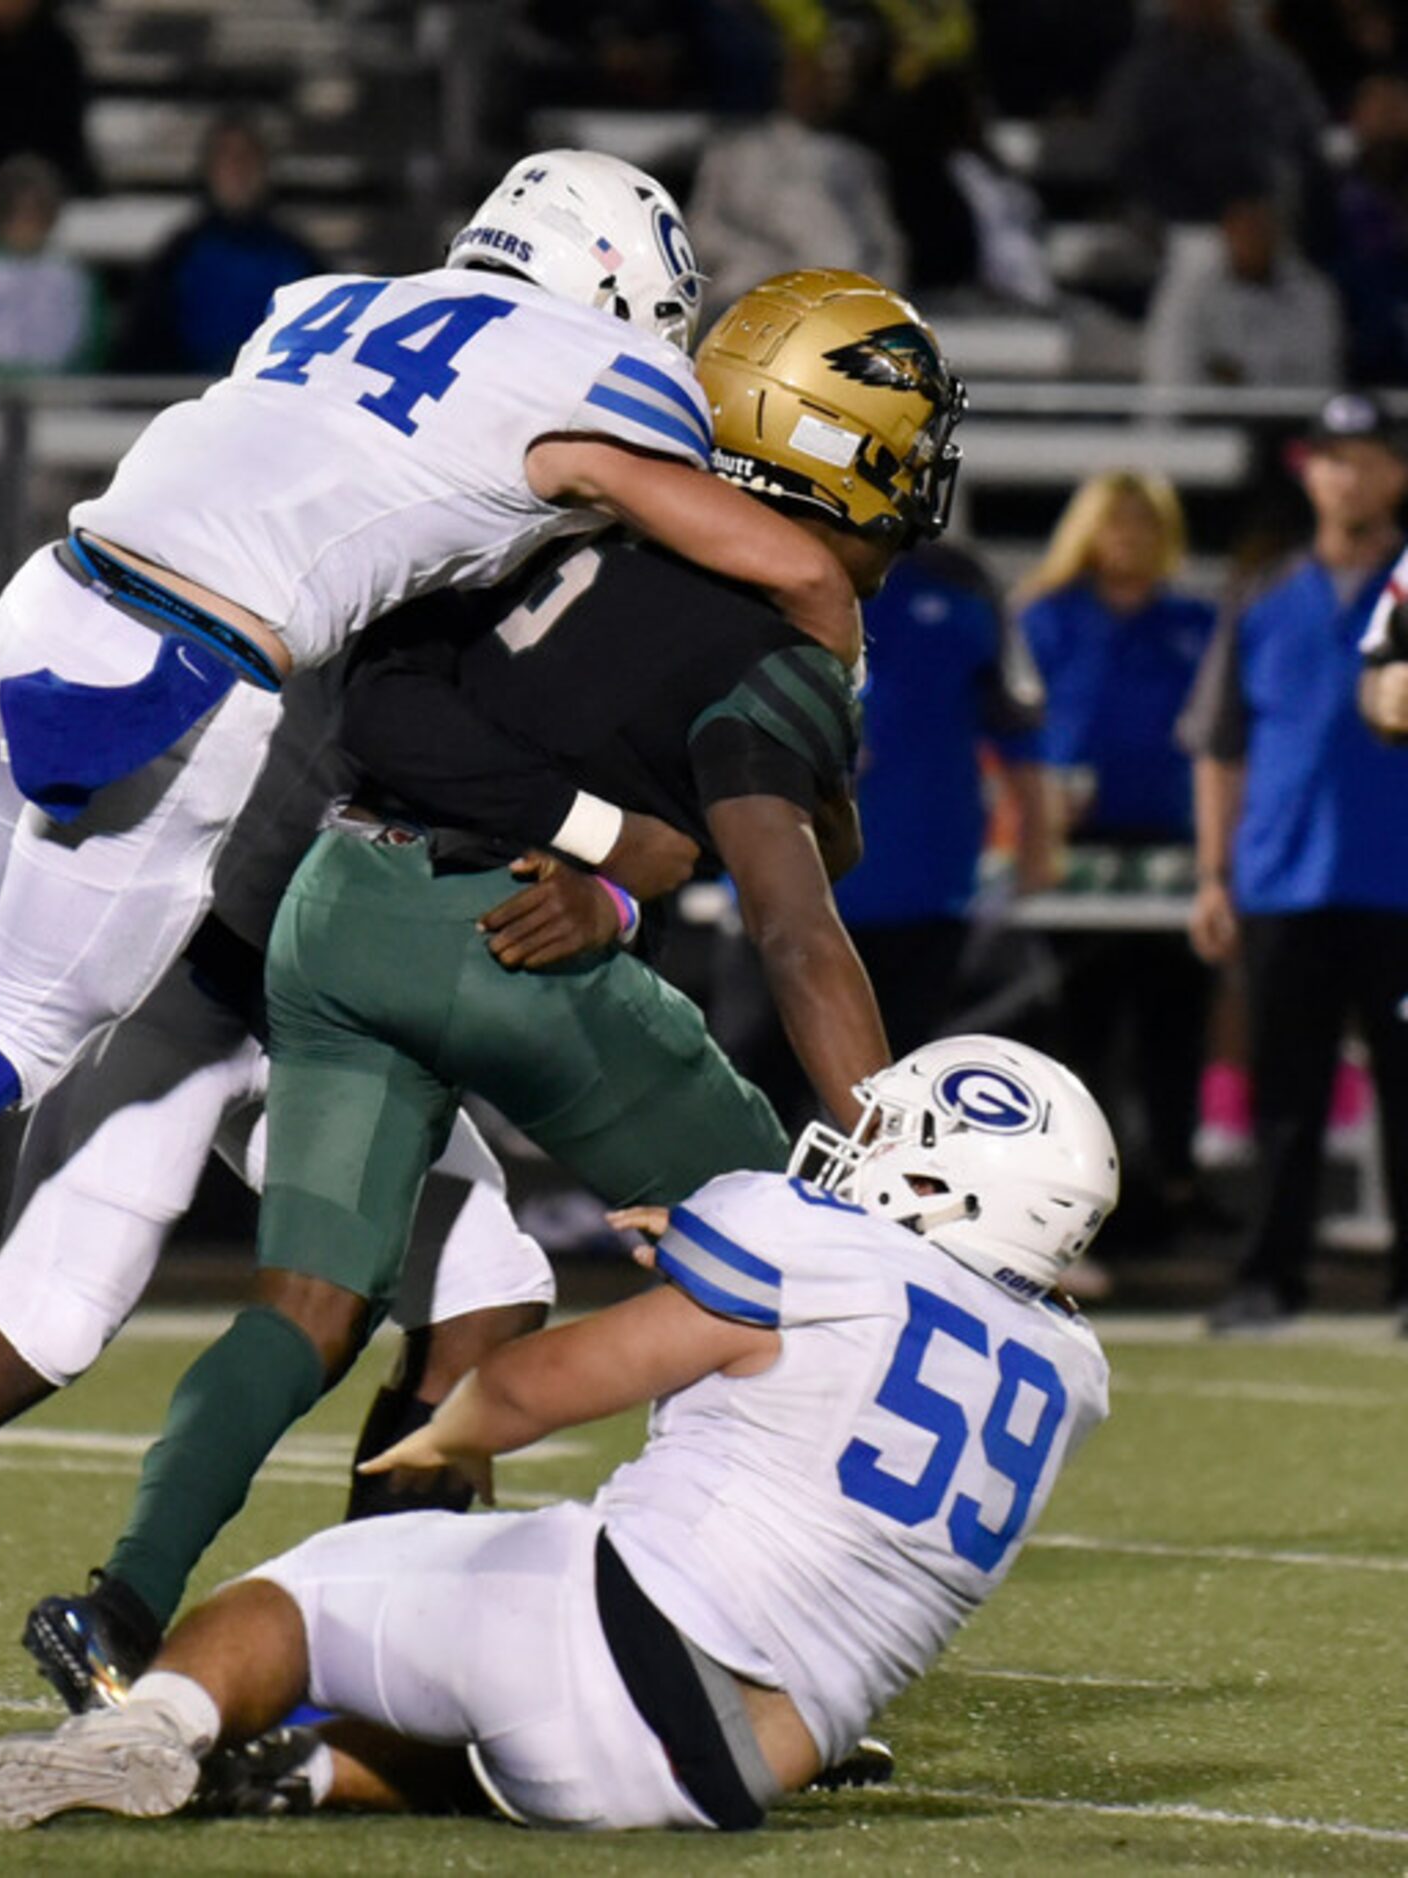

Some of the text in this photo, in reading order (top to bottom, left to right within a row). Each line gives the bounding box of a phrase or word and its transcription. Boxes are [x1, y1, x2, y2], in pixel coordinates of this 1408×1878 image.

[256, 281, 518, 437] 44
[941, 1066, 1033, 1129] G
[836, 1282, 1066, 1573] 59
